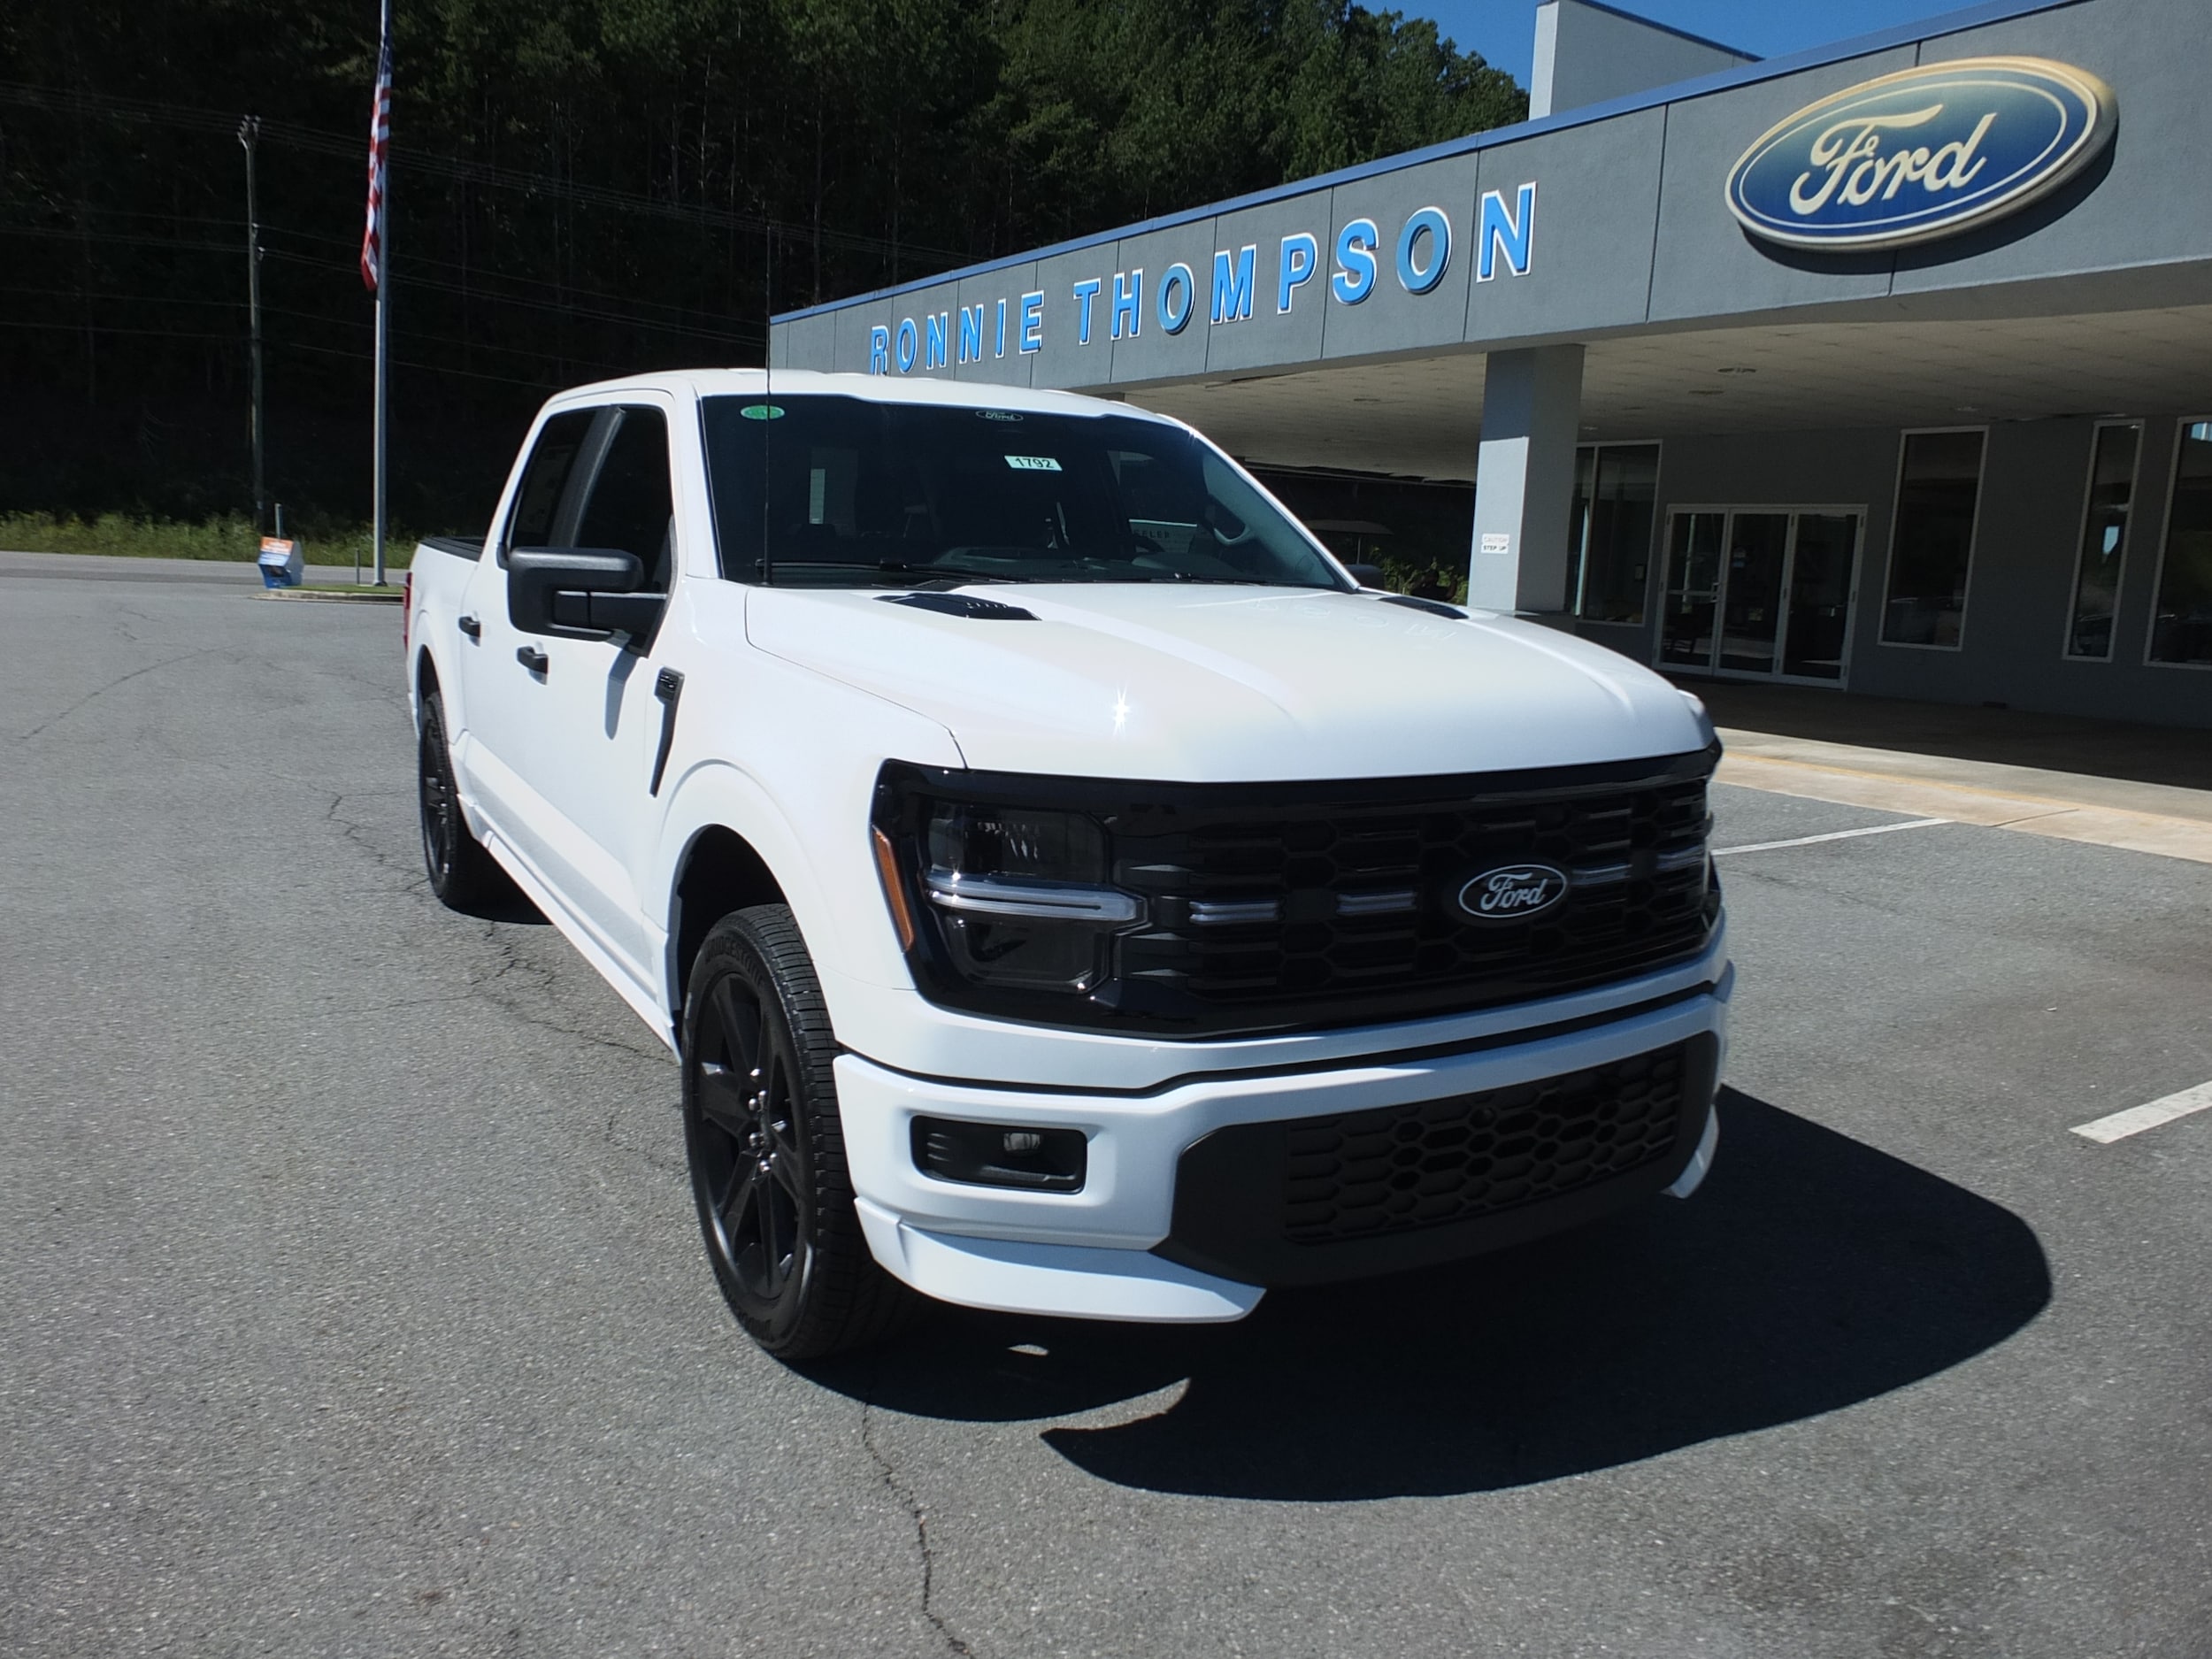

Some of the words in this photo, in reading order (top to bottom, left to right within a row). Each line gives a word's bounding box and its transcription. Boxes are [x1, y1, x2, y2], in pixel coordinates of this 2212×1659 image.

[1789, 104, 1998, 215] Ford
[870, 290, 1044, 375] RONNIE
[1073, 181, 1538, 346] THOMPSON
[984, 411, 1015, 421] Ford
[1015, 457, 1056, 469] 1792
[1480, 872, 1548, 910] Ford
